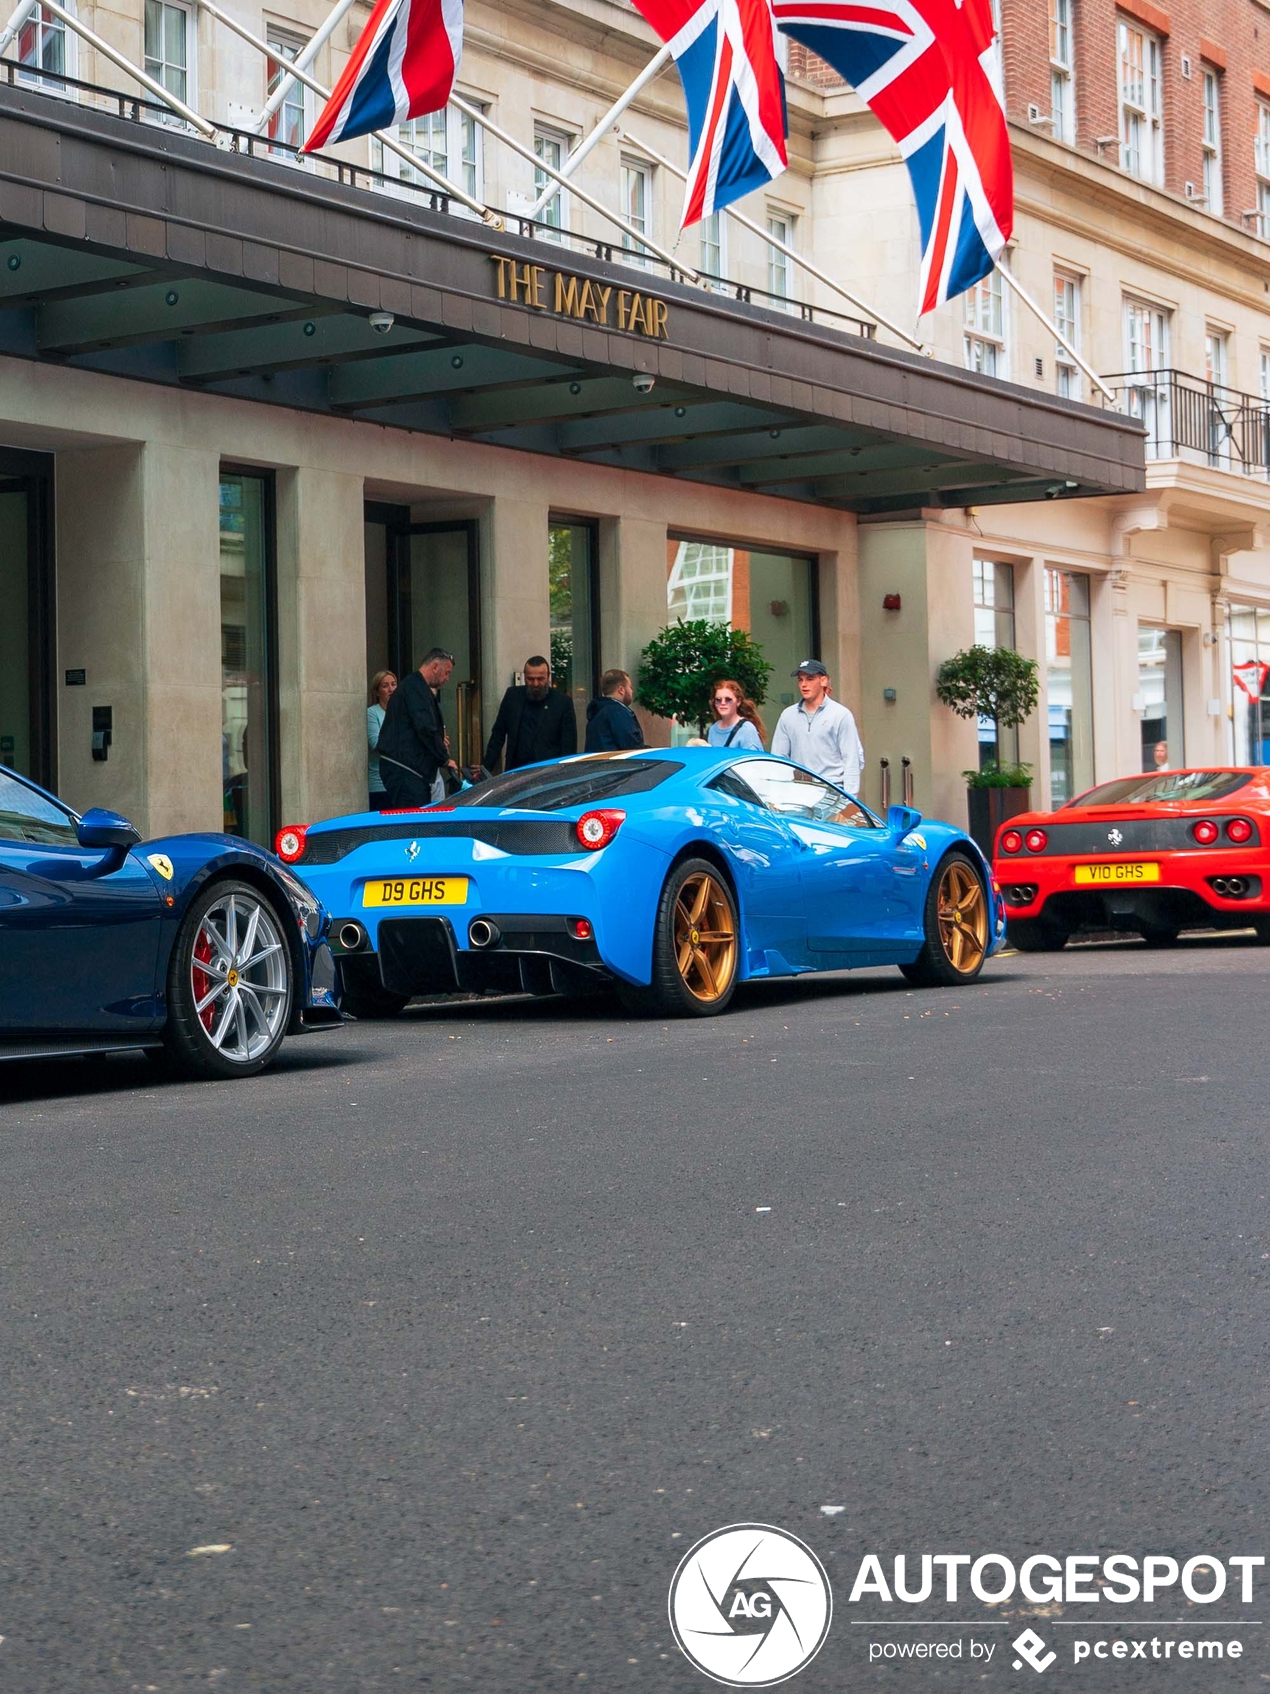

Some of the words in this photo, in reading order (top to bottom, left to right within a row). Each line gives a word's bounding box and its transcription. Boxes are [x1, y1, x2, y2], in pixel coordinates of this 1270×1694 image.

[490, 254, 547, 309] THE
[554, 272, 612, 325] MAY
[617, 289, 669, 340] FAIR
[1090, 865, 1111, 879] V10
[1115, 865, 1144, 879] GHS
[381, 882, 405, 902] D9
[409, 881, 446, 900] GHS
